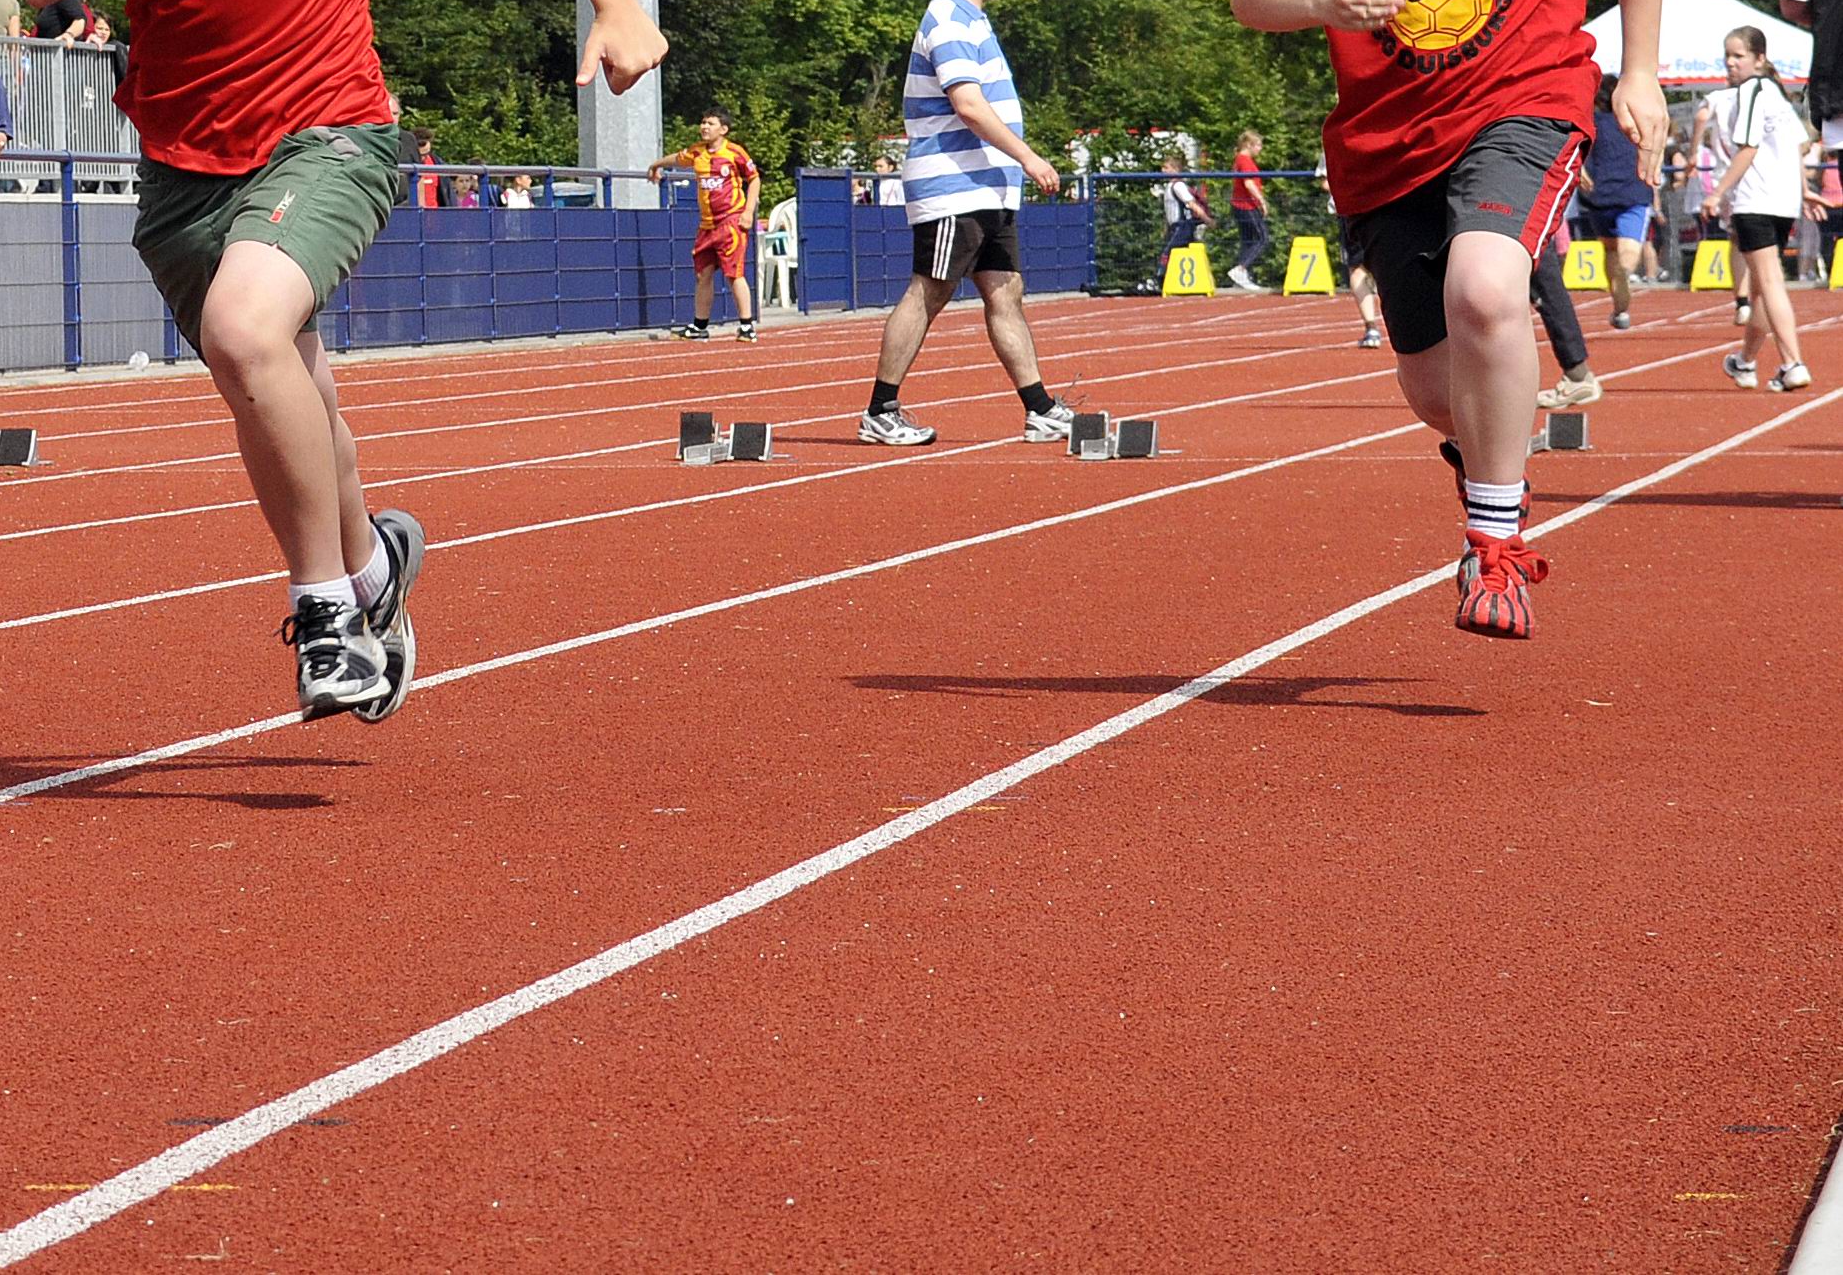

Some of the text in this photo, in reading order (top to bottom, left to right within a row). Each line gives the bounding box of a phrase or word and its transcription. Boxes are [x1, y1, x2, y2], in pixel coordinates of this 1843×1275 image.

[1675, 58, 1724, 72] Foto-S
[1178, 256, 1196, 288] 8
[1299, 253, 1317, 286] 7
[1576, 249, 1596, 282] 5
[1708, 249, 1725, 282] 4
